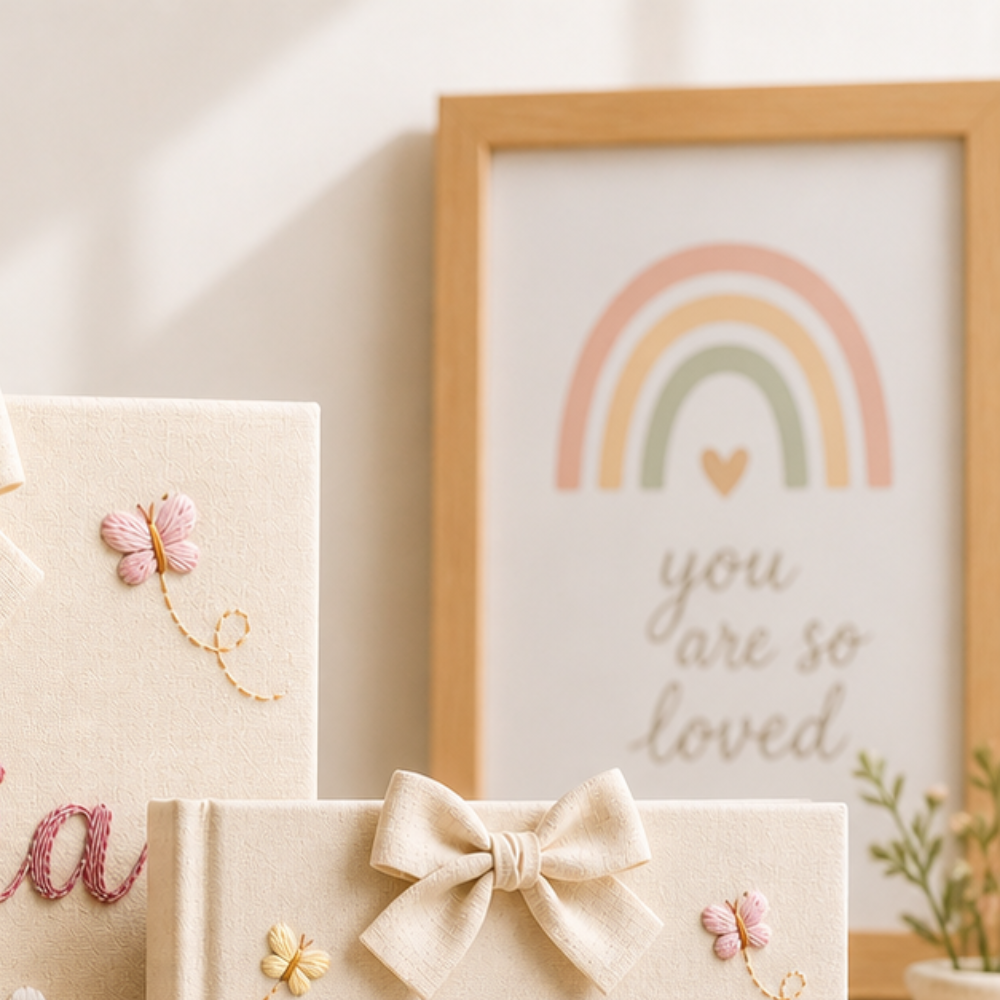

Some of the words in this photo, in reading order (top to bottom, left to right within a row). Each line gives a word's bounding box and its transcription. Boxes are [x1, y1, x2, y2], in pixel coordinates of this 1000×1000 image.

[645, 546, 801, 645] you
[674, 620, 779, 671] are
[795, 617, 873, 675] so
[627, 680, 850, 764] loved
